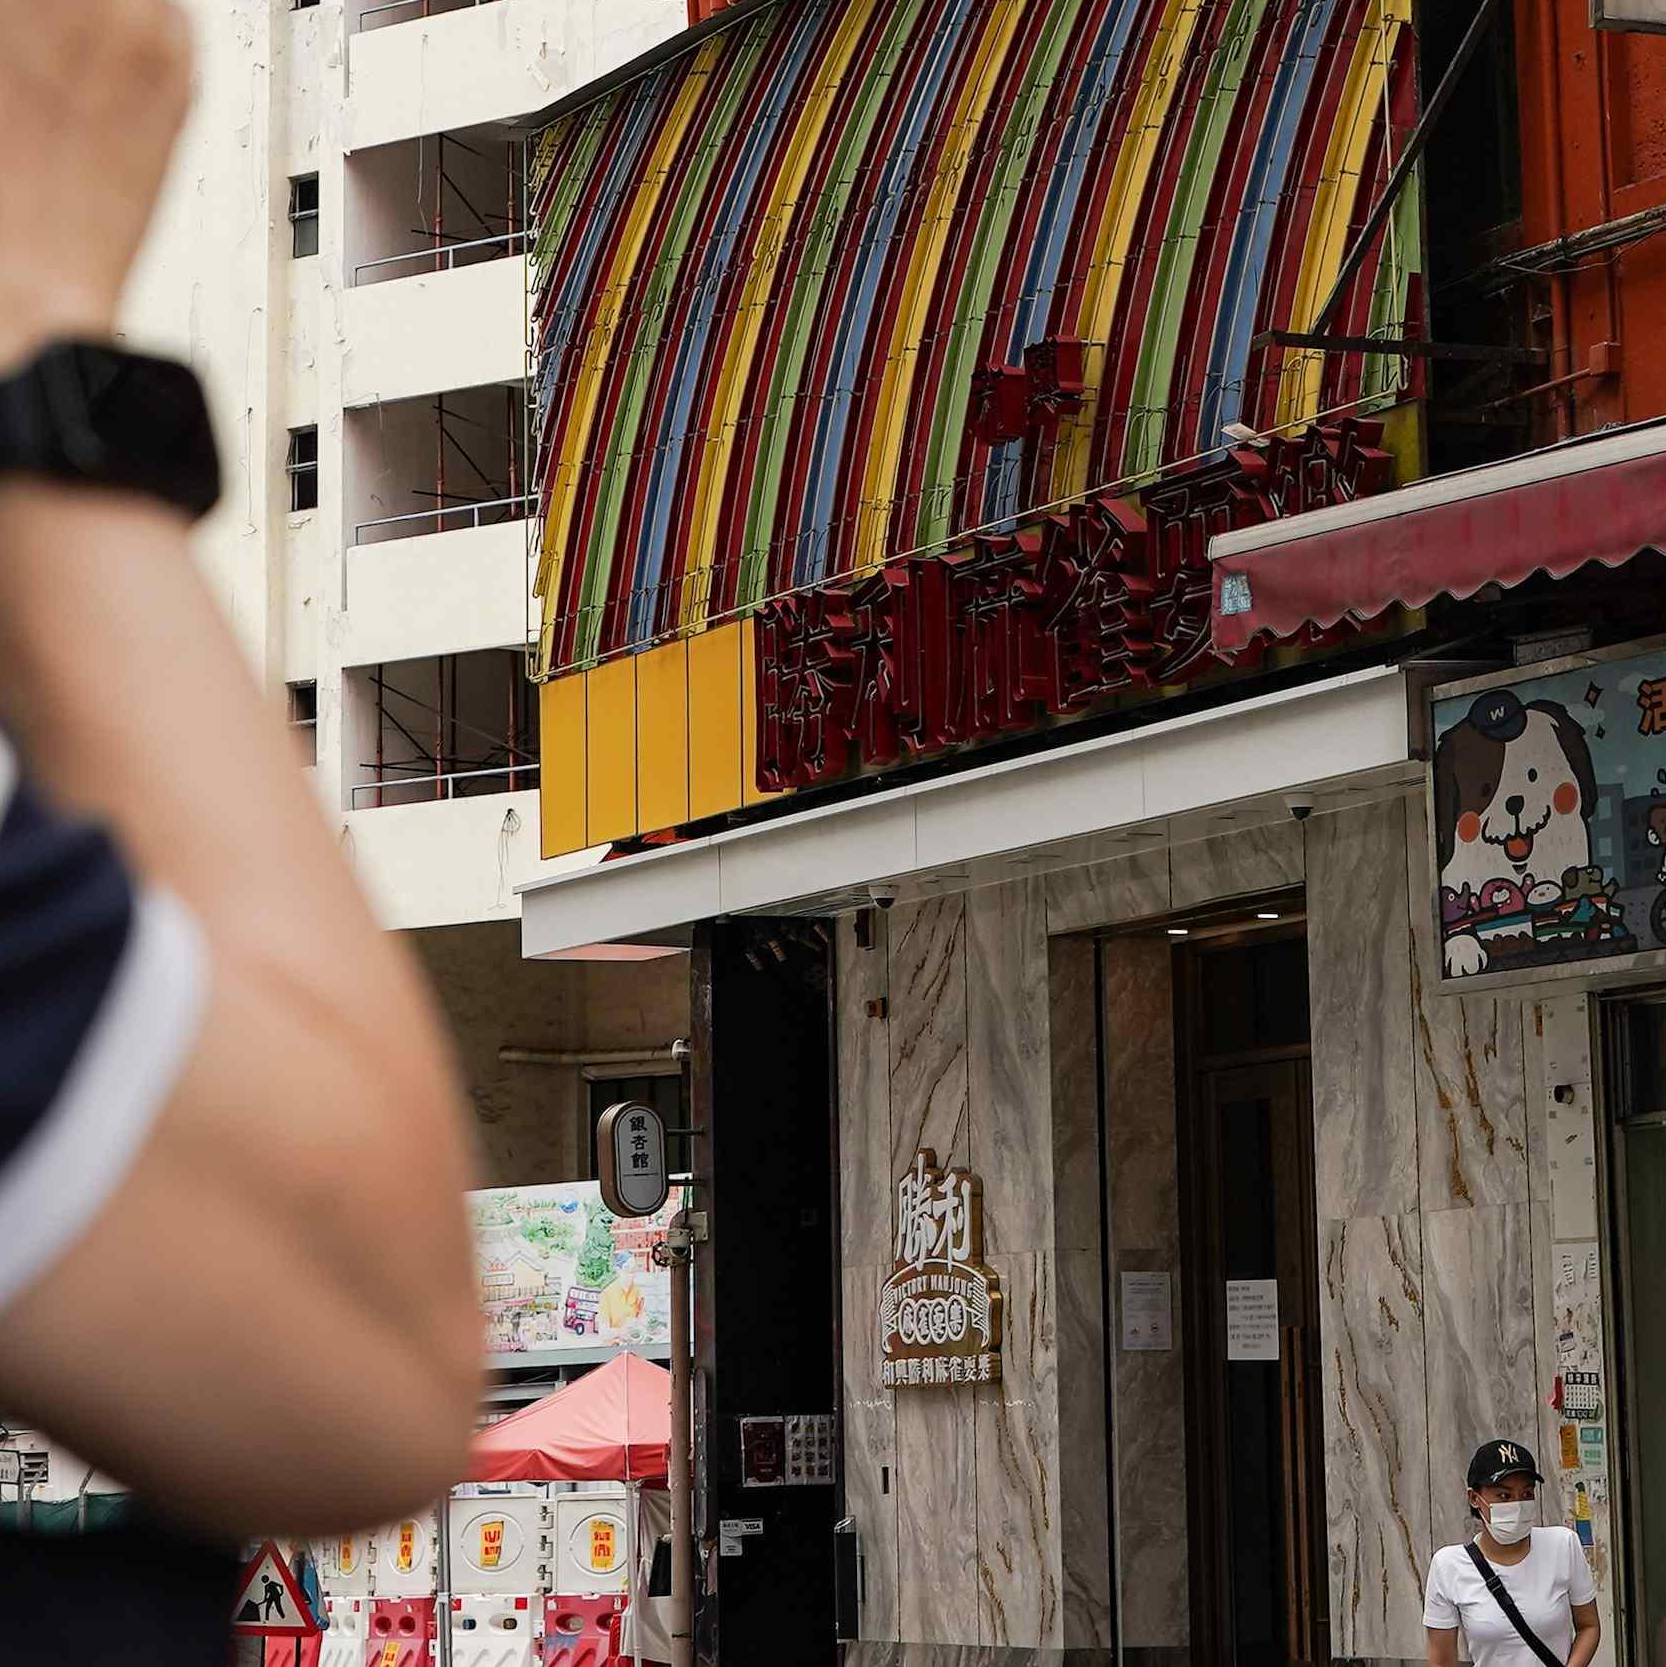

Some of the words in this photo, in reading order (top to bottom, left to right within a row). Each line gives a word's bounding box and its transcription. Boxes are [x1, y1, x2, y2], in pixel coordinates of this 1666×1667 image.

[1489, 706, 1505, 722] W
[629, 1115, 650, 1169] 銀杏館
[896, 1152, 971, 1273] 勝利
